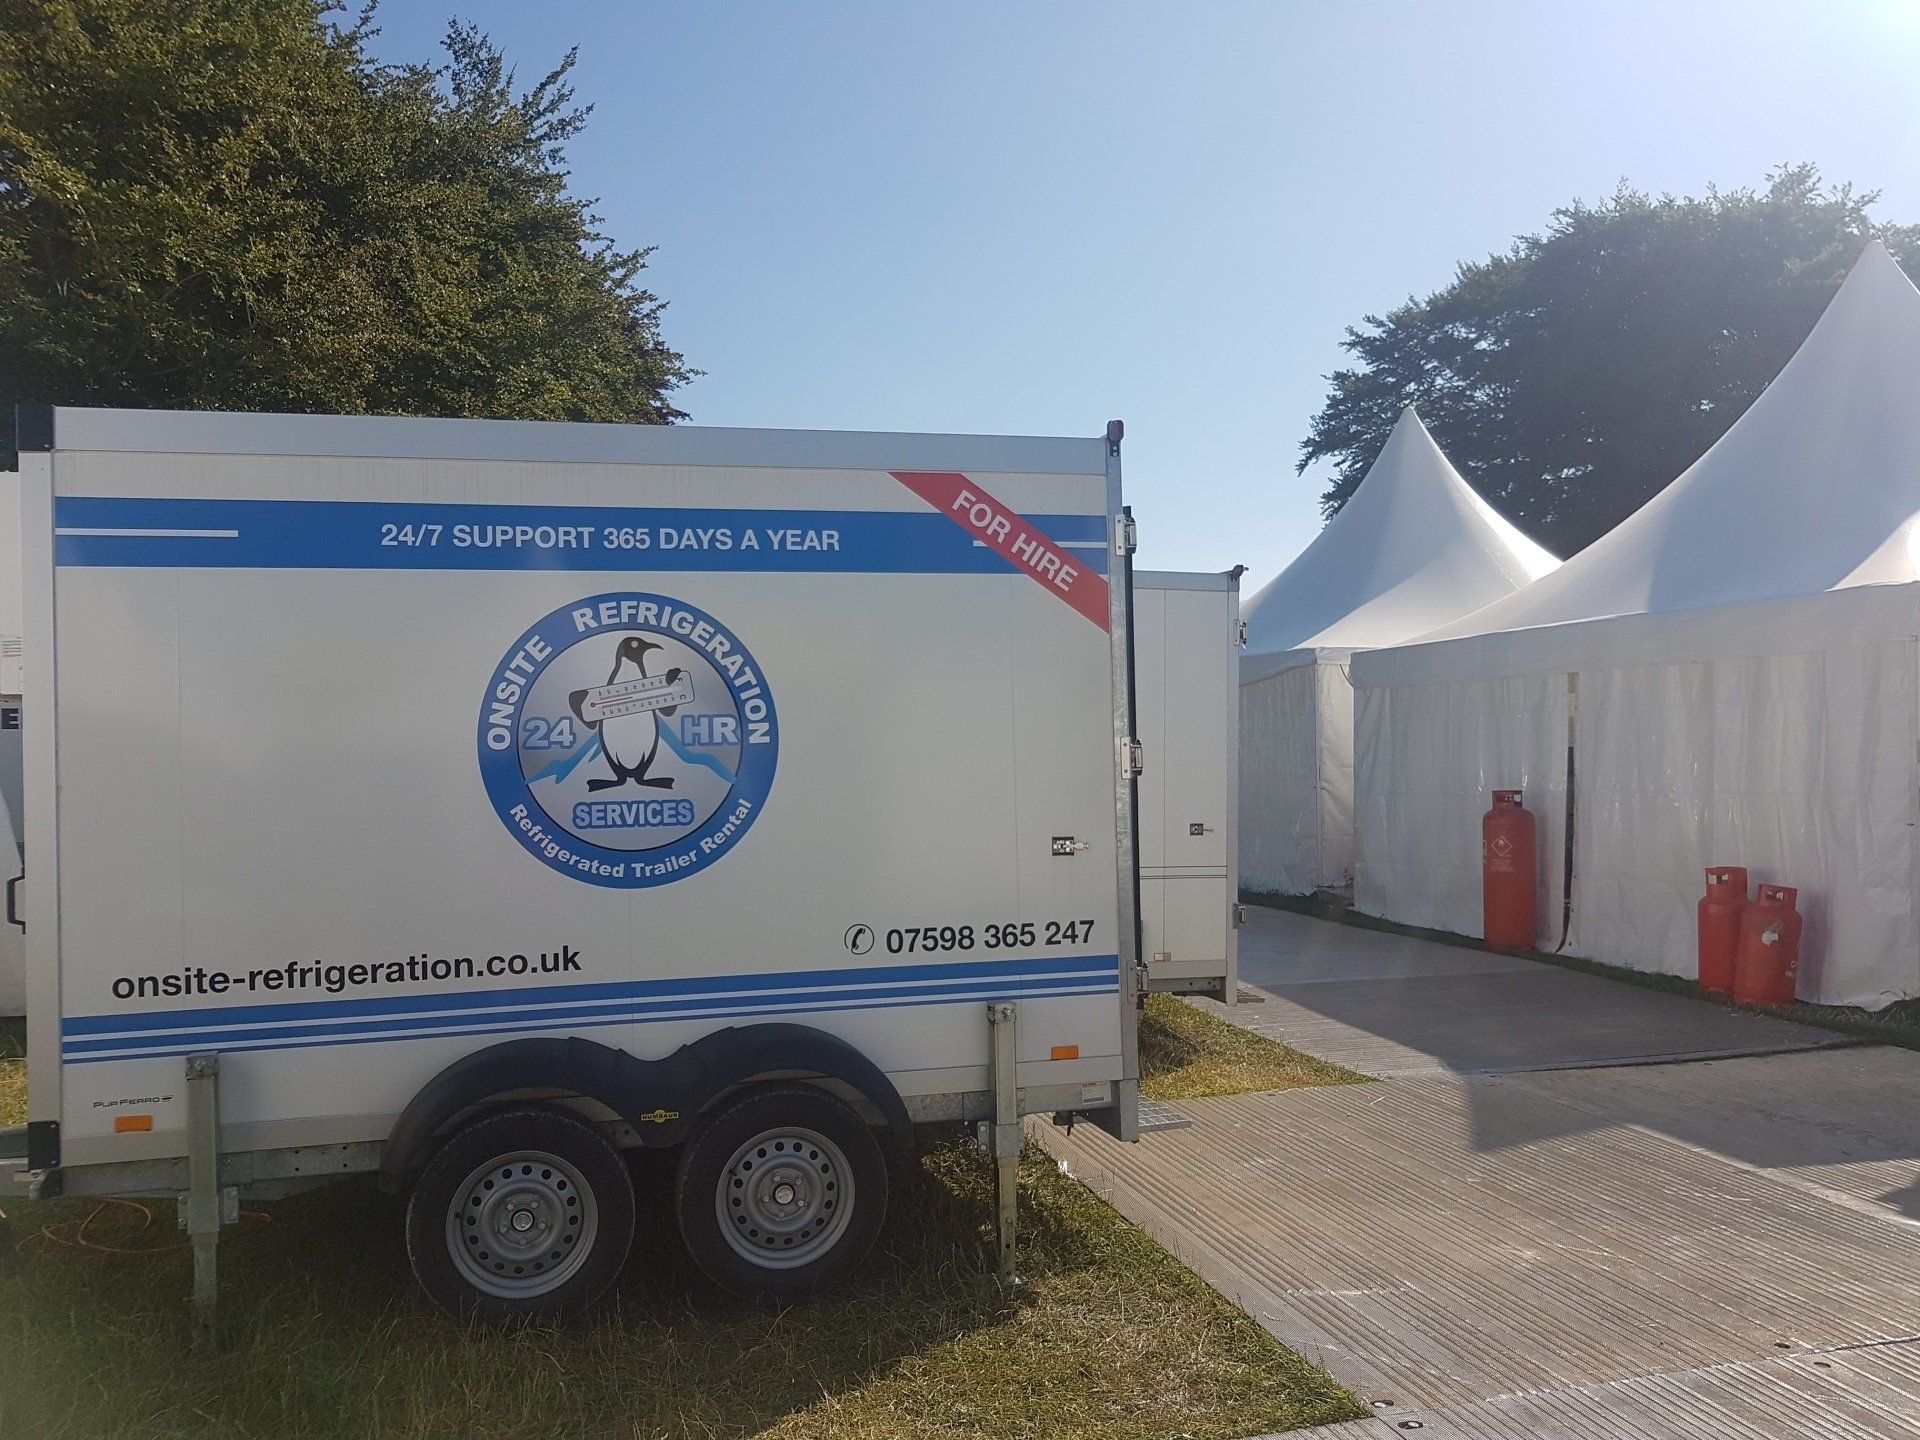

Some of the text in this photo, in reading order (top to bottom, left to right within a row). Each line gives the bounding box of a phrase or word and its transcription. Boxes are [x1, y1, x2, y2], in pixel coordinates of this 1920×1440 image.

[381, 524, 840, 551] 24/7 SUPPORT 365 DAYS A YEAR
[952, 489, 1078, 592] FOR HIRE
[487, 600, 771, 750] ONSITE REFRIGERATION
[523, 715, 739, 749] 24 HR
[573, 801, 695, 829] SERVICES
[509, 798, 752, 878] Refrigerated Trailer Rental
[886, 919, 1095, 954] 07598 365 247
[111, 945, 582, 999] onsite-refrigeration.co.uk
